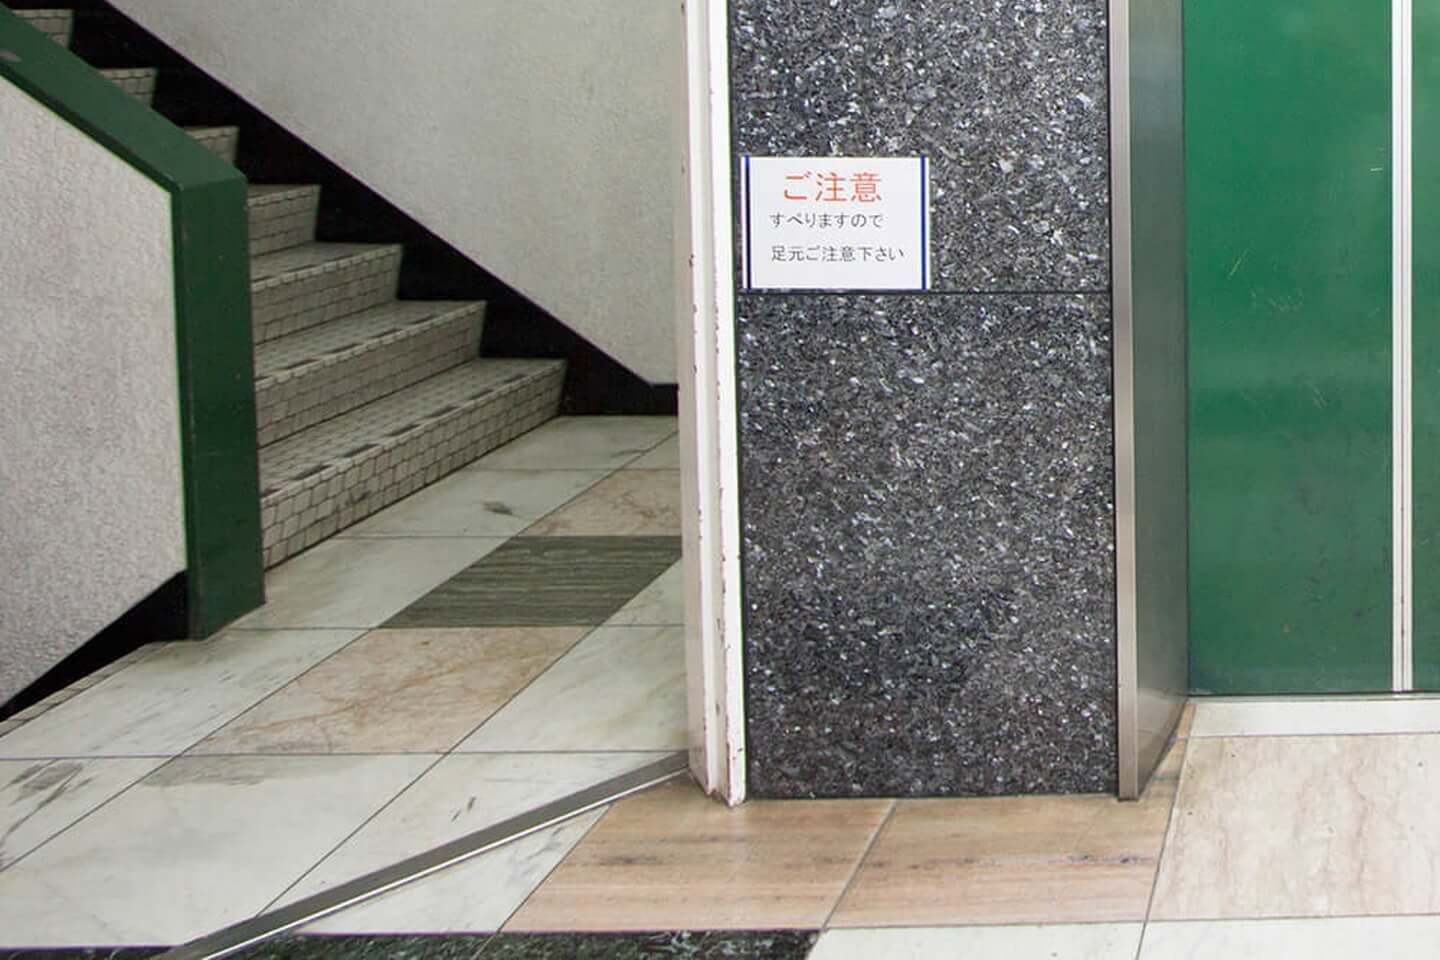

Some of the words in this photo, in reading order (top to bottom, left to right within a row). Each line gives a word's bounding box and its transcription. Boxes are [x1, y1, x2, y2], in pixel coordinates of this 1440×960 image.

[784, 172, 882, 203] ご注意
[770, 213, 882, 228] すべりますので
[771, 245, 906, 262] 足元ご注意下さい
